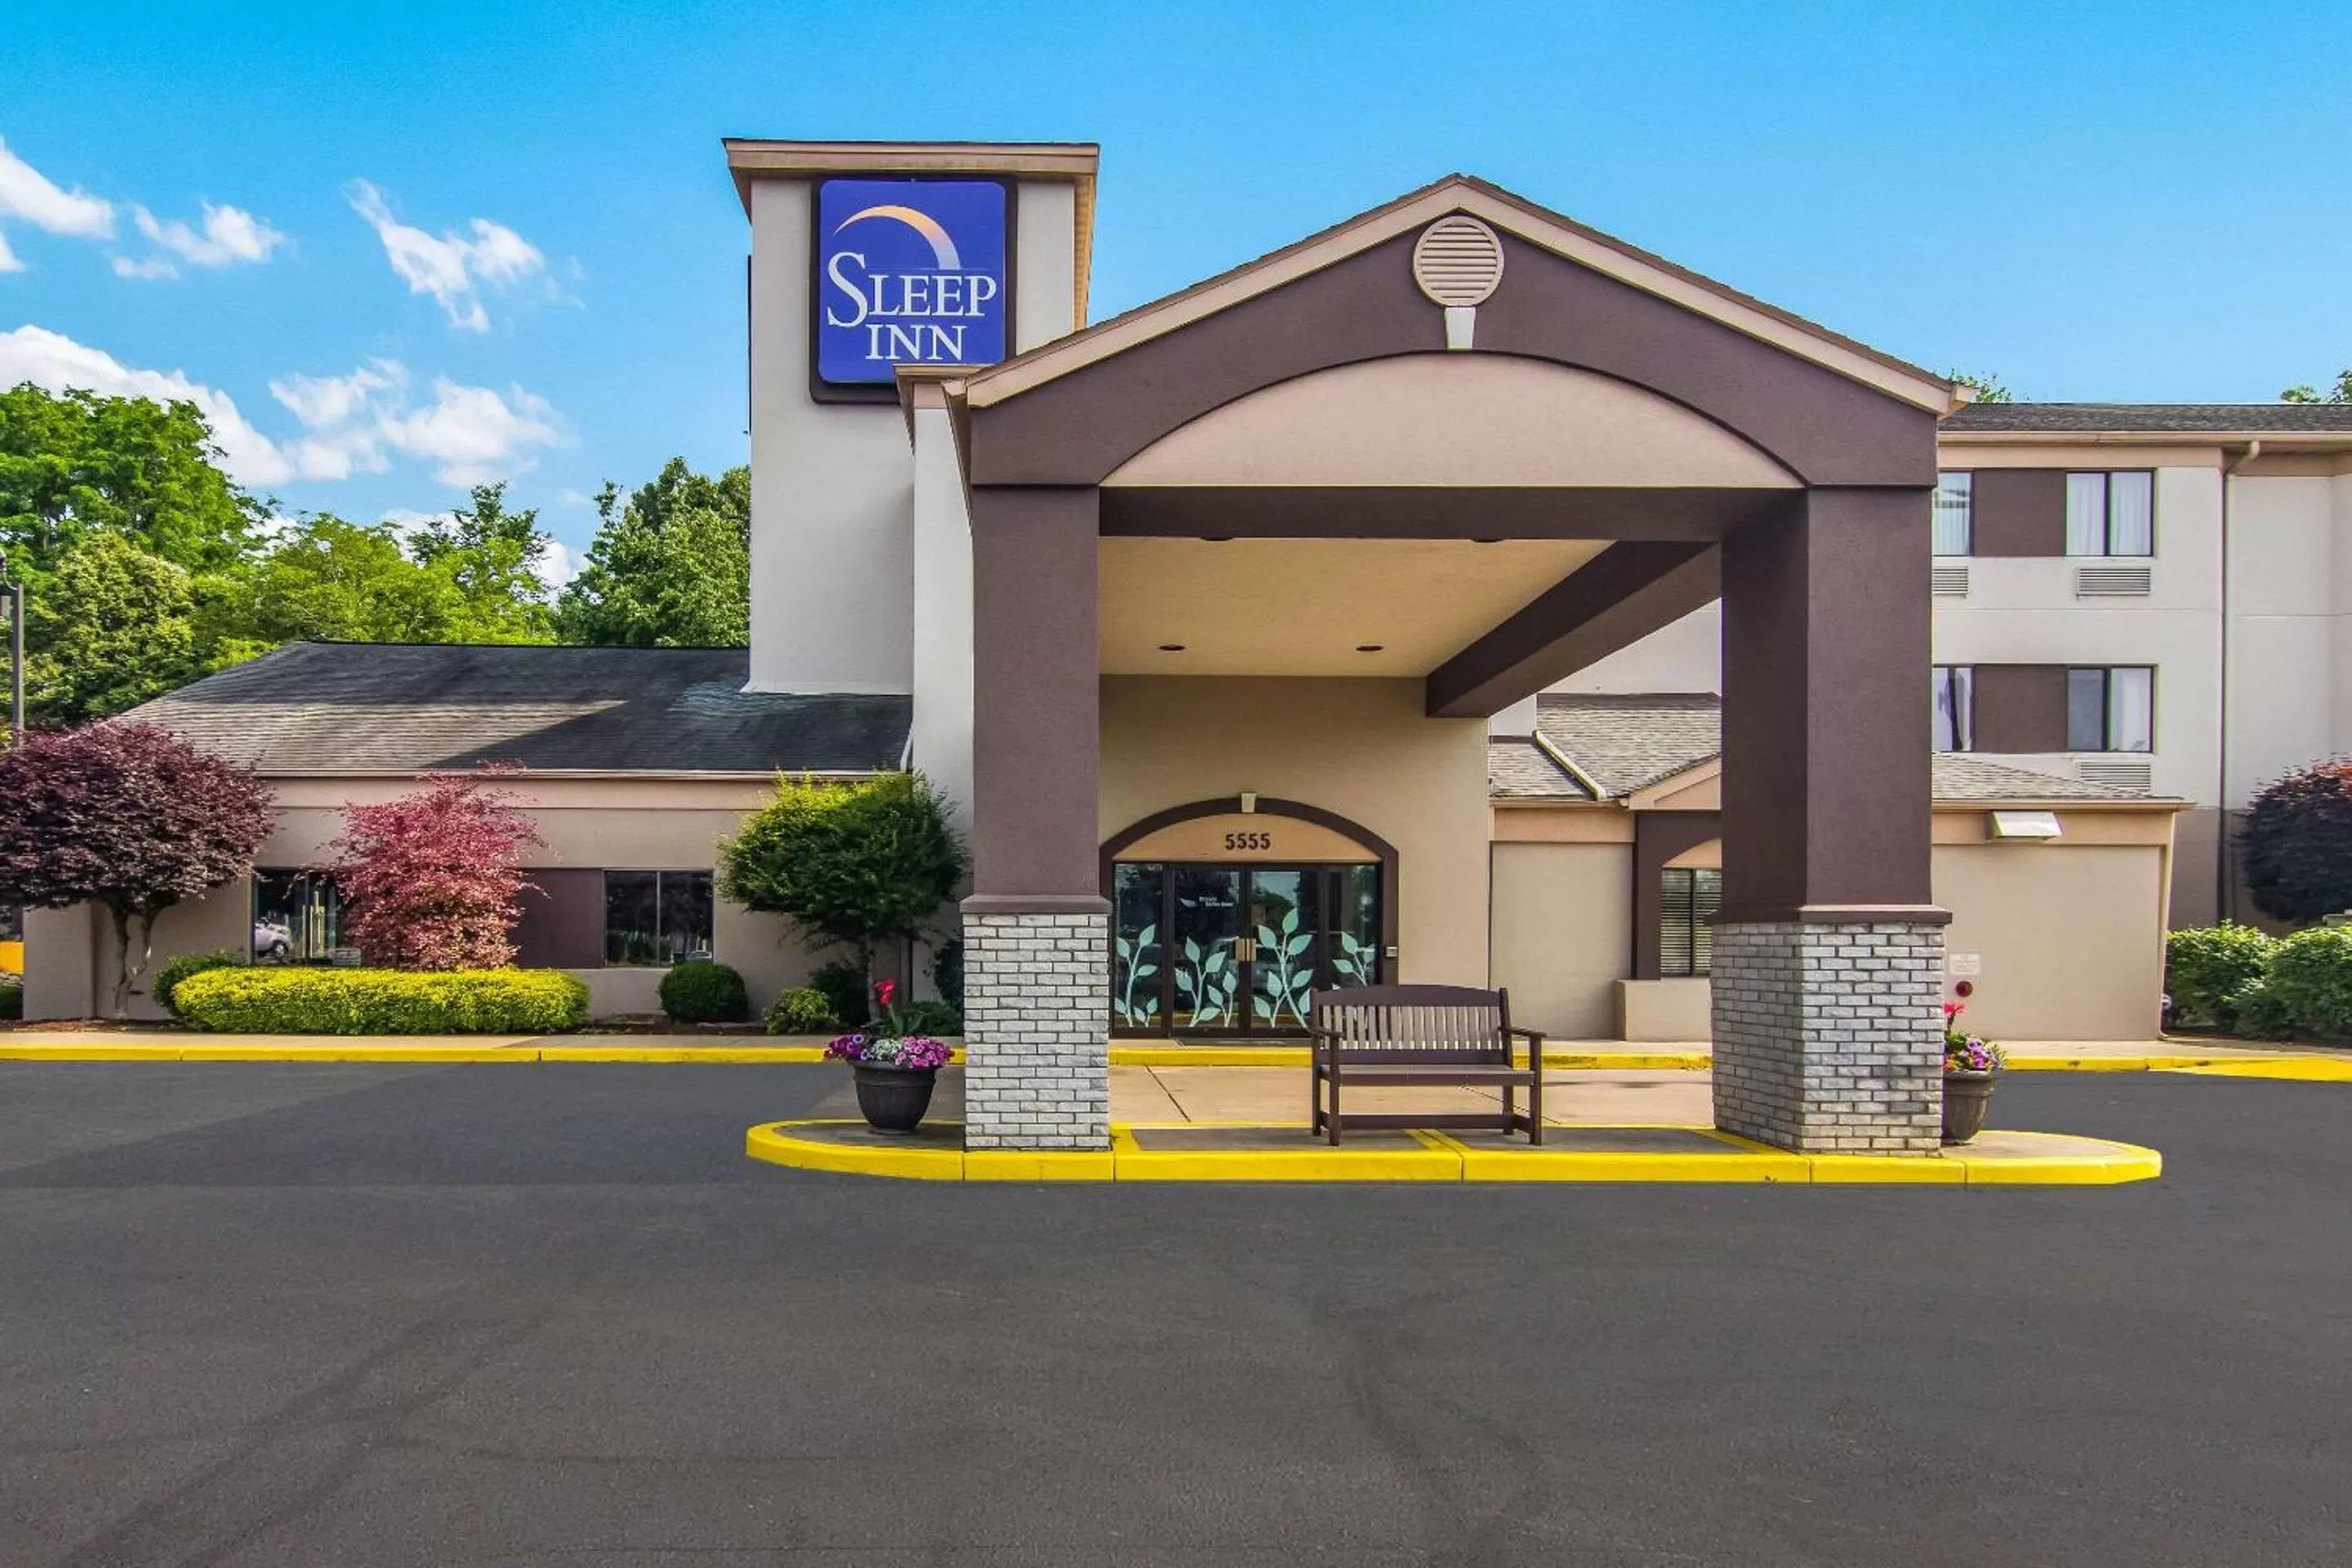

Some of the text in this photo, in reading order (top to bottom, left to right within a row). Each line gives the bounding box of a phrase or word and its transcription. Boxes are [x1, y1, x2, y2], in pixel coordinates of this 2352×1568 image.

[827, 252, 997, 327] SLEEP
[865, 323, 967, 361] INN
[1225, 832, 1272, 851] 5555
